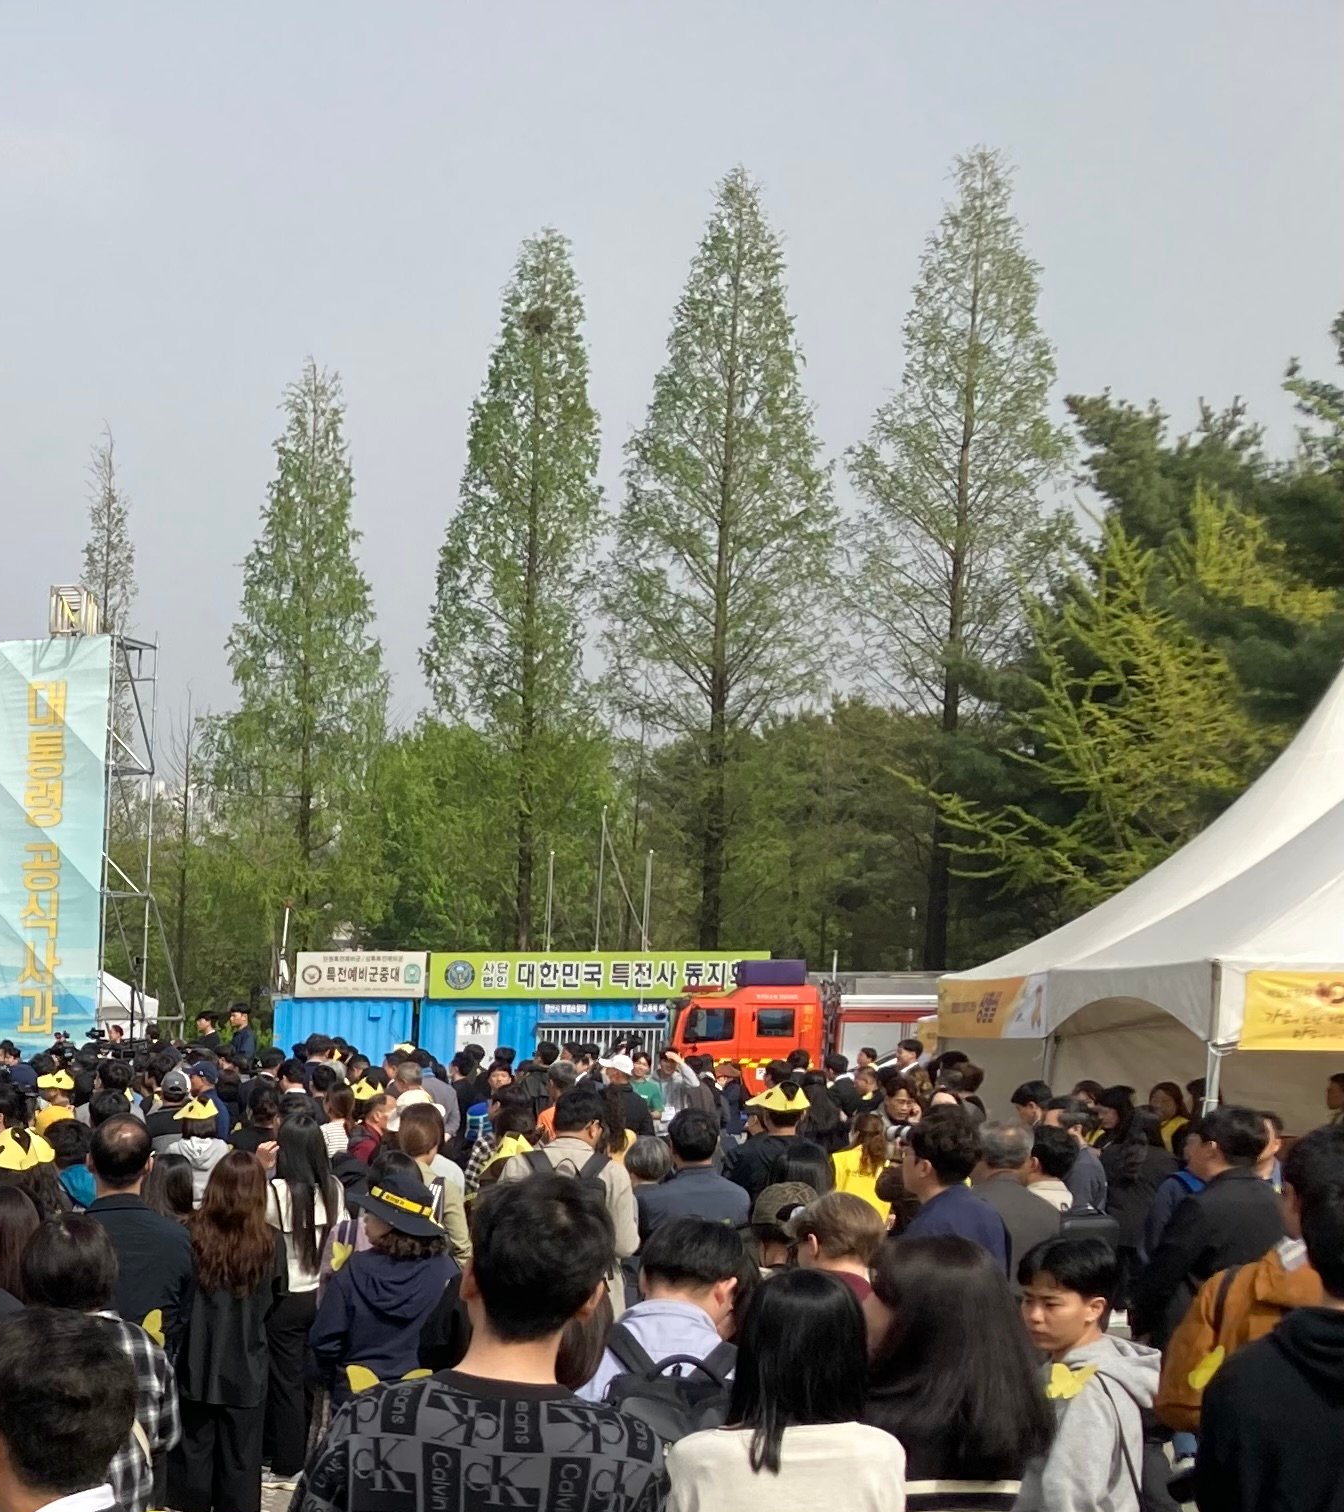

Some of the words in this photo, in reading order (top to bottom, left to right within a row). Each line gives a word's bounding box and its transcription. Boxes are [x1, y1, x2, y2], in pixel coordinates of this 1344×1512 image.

[25, 681, 68, 828] 대통령
[17, 843, 61, 1035] 공식사과
[326, 966, 400, 983] 특전예비군중대
[483, 962, 508, 974] 사단
[518, 962, 603, 988] 대한민국
[611, 962, 677, 988] 특전사
[483, 976, 508, 987] 법인
[431, 1452, 453, 1511] Calvin
